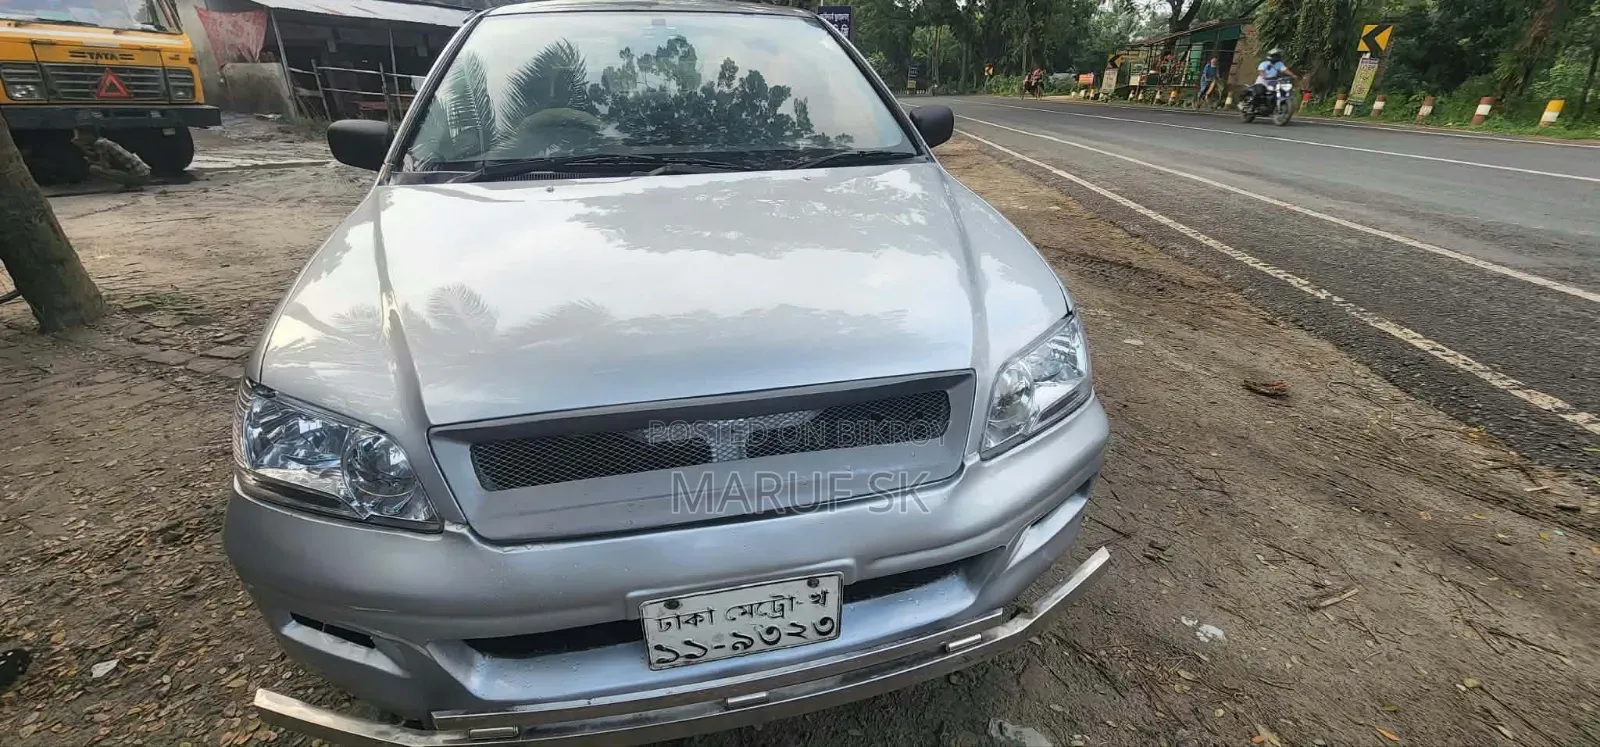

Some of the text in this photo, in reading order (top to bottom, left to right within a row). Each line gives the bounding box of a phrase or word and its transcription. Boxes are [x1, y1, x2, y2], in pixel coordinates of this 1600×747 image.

[87, 52, 119, 61] TATA
[656, 607, 716, 632] ঢাকা
[654, 616, 835, 664] ১১-৯৩২৩
